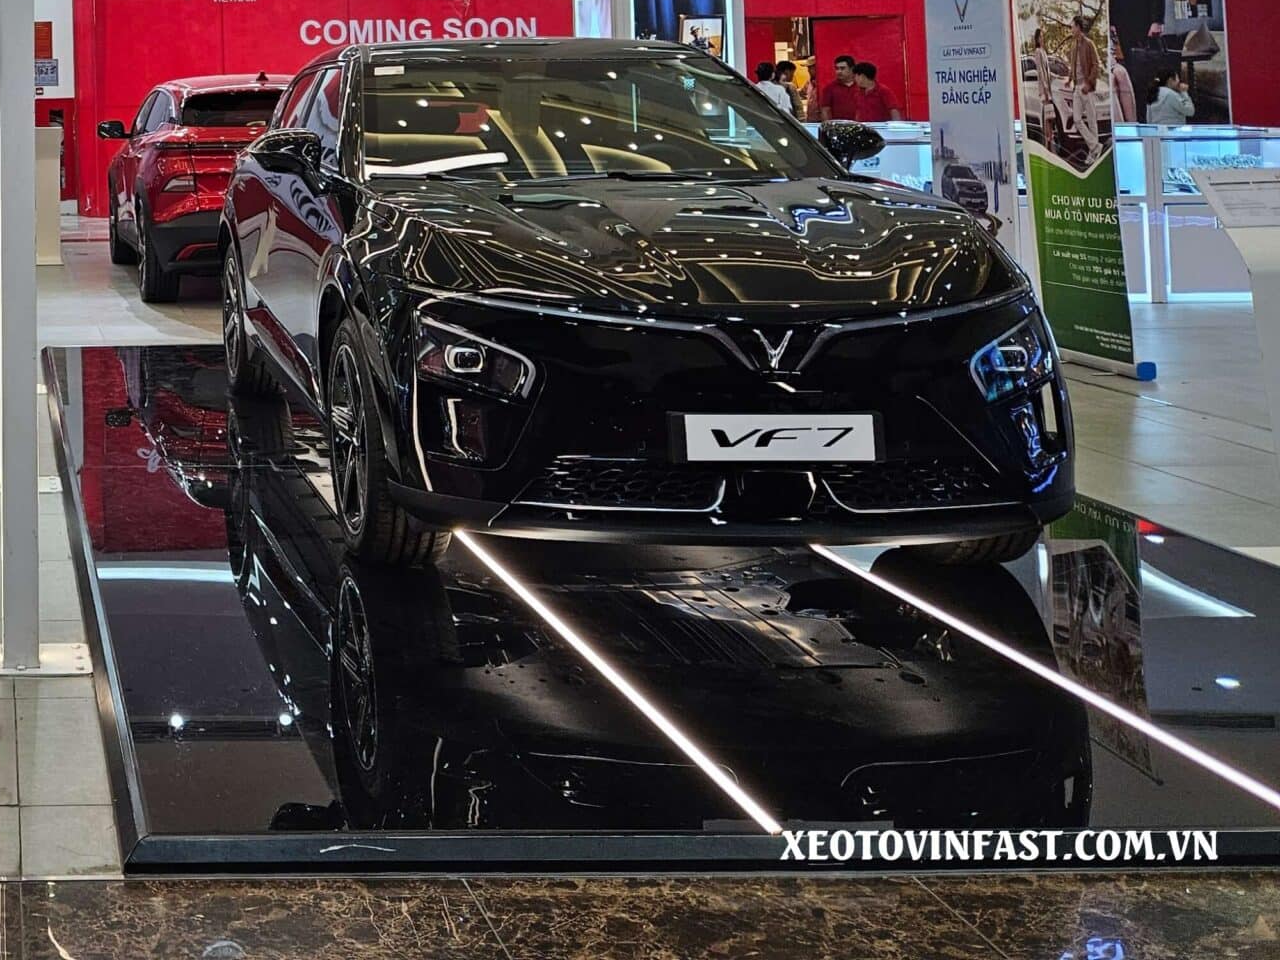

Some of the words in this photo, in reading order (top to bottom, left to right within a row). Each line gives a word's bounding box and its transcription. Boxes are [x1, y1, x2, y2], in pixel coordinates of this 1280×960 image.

[300, 18, 433, 45] COMING
[443, 16, 537, 40] SOON
[959, 66, 997, 86] NGHIỆM
[972, 86, 992, 104] CẤP
[1051, 194, 1070, 206] CHO
[1071, 195, 1085, 207] VAY
[1044, 208, 1062, 220] MUA
[1064, 207, 1071, 220] Ô
[1072, 209, 1083, 222] TÔ
